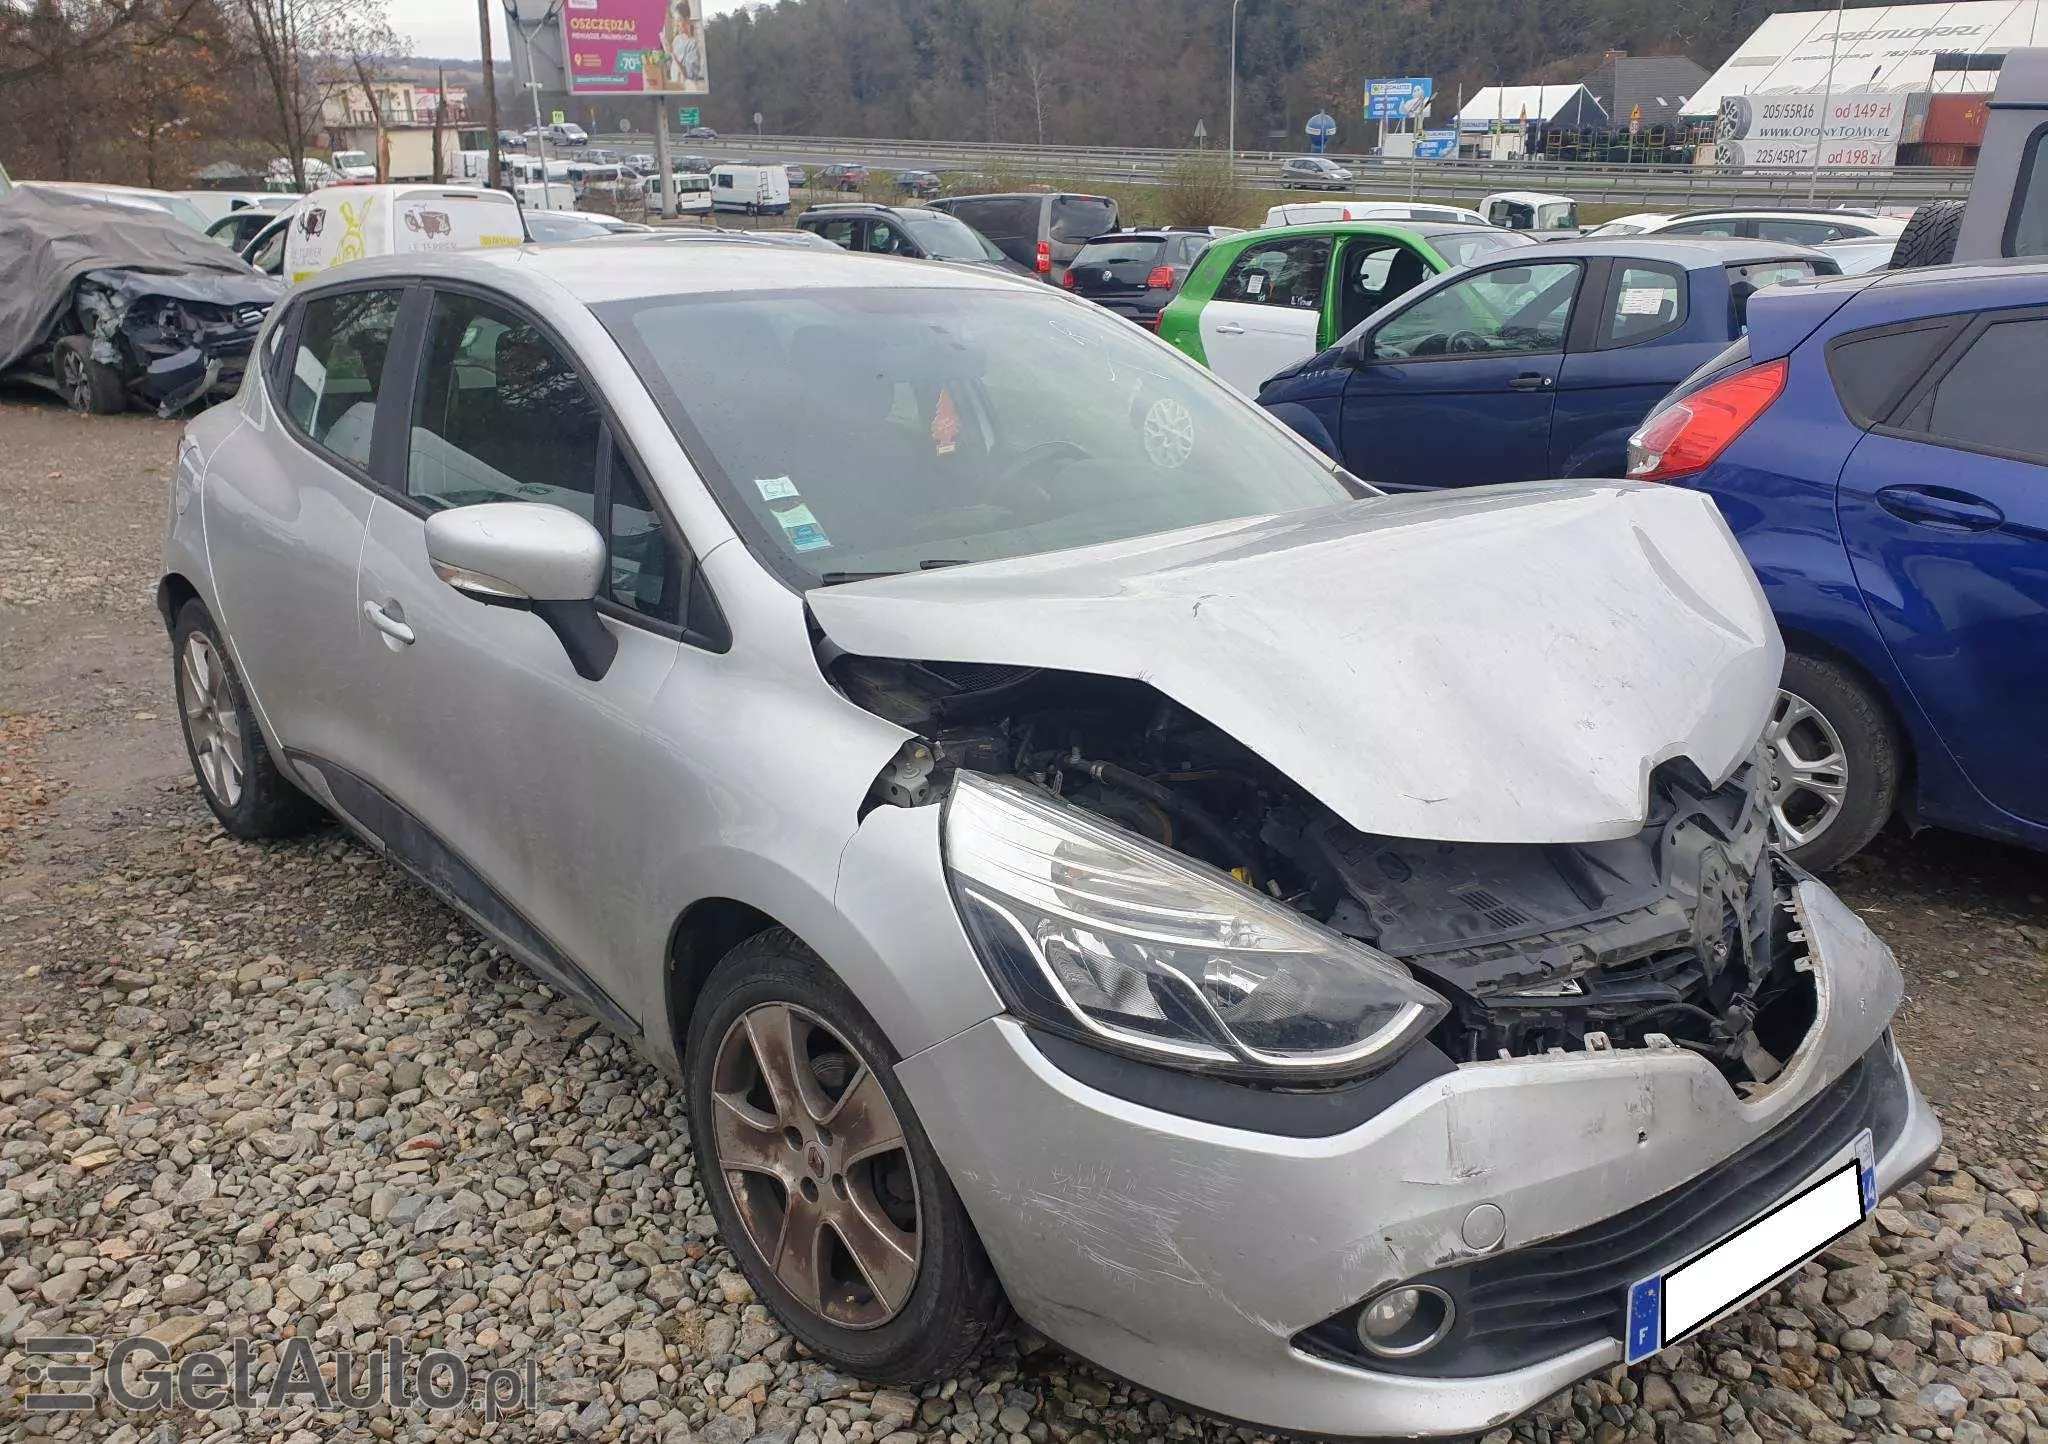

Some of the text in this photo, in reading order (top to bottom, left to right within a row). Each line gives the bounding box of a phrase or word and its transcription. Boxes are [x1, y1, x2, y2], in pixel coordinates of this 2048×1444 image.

[1762, 103, 1815, 119] 205/55R16
[1835, 102, 1892, 118] od 149 zł
[1755, 149, 1808, 164] 225/45R17
[1827, 149, 1882, 164] od 198 zł
[1638, 1326, 1650, 1346] F
